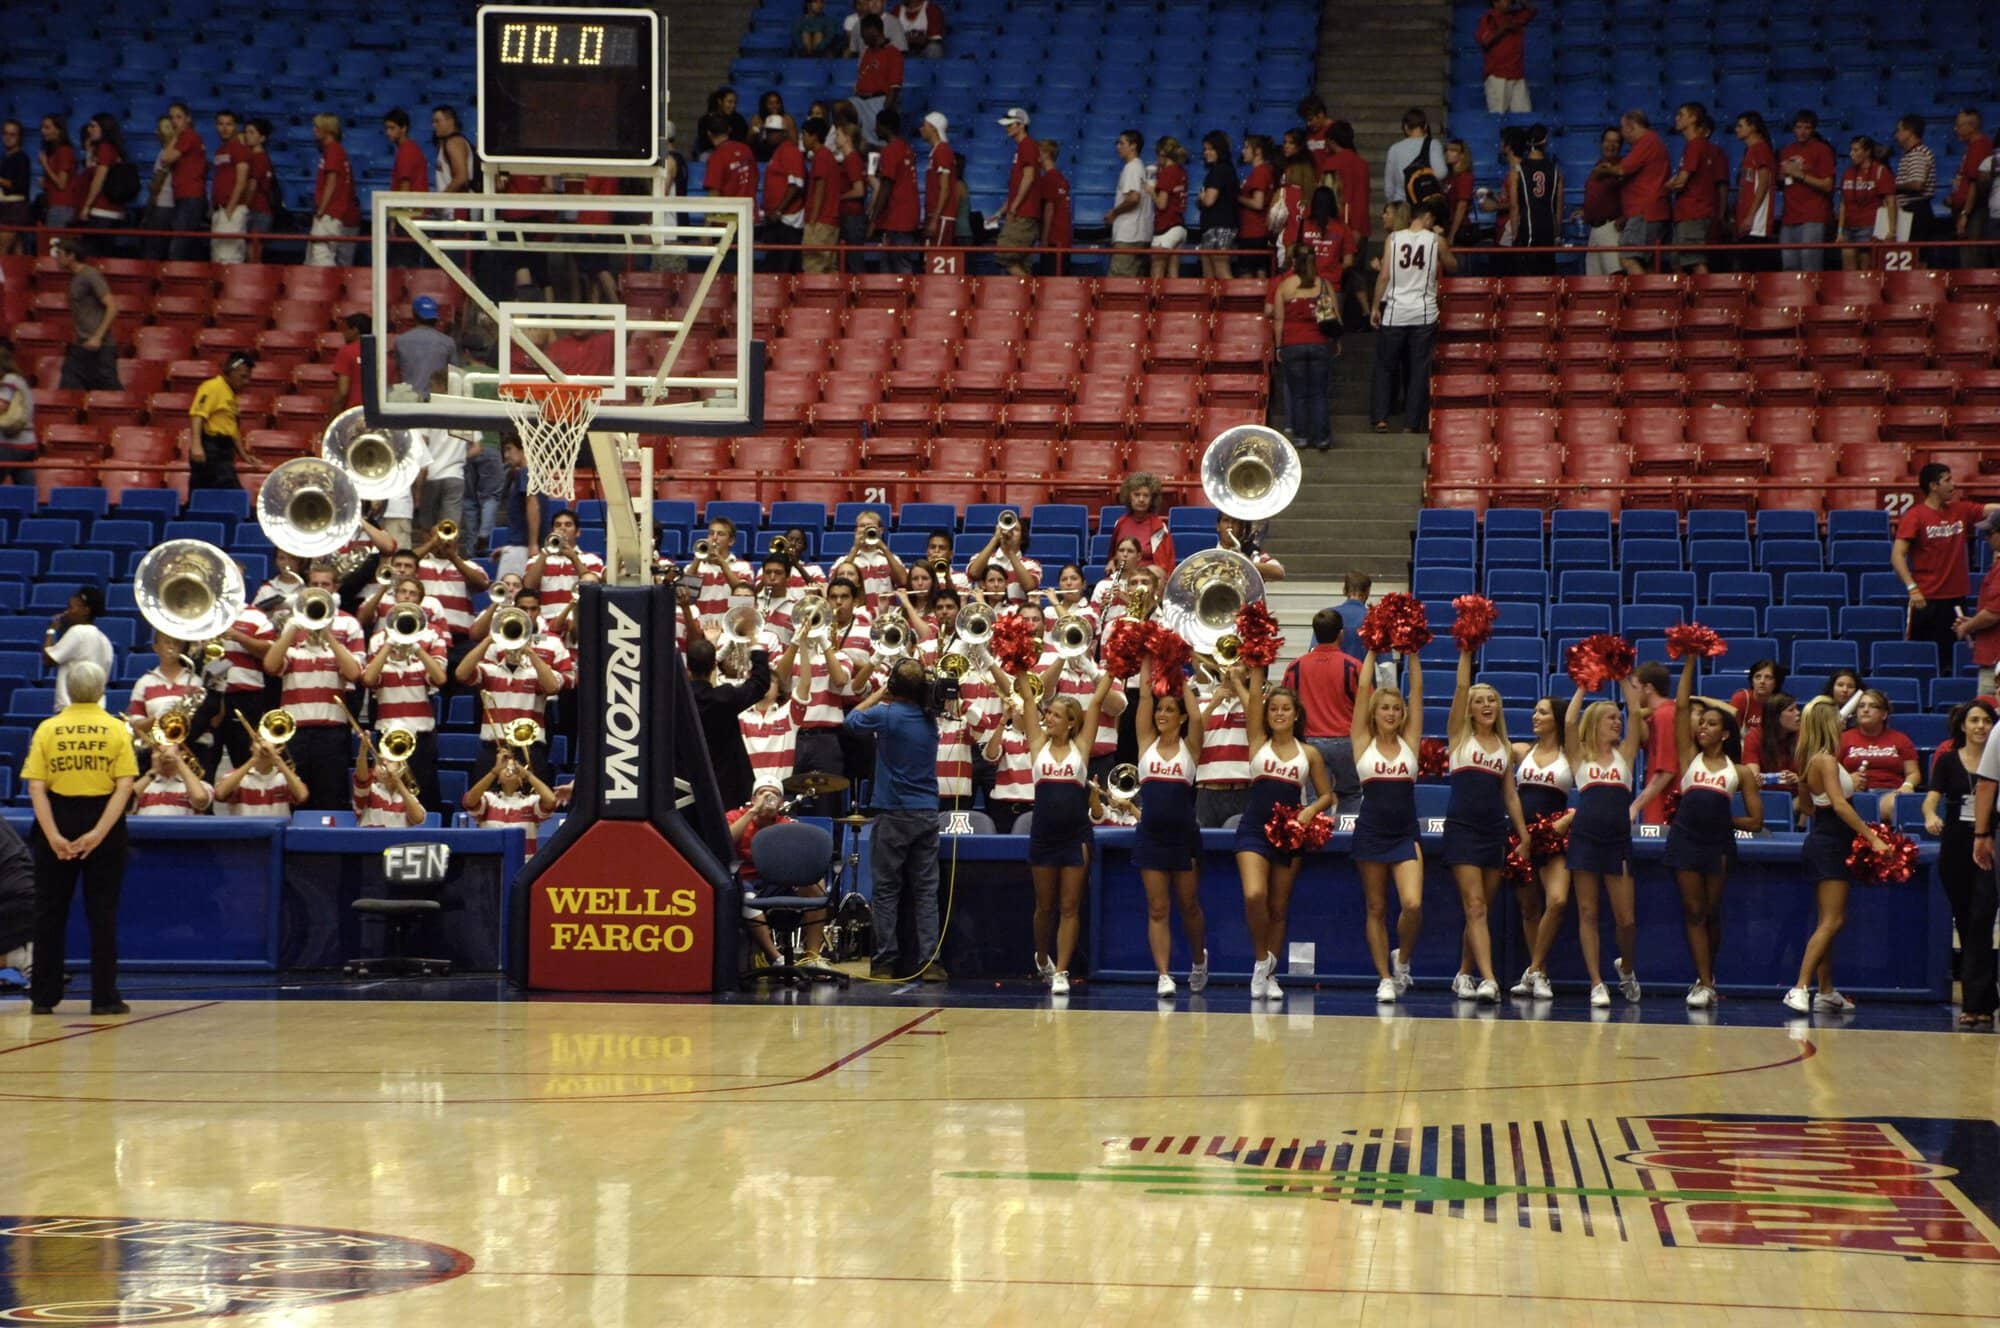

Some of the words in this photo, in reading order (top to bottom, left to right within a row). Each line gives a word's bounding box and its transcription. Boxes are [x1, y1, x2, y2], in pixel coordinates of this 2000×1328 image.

[501, 24, 604, 65] 00.0
[1532, 170, 1546, 198] 3
[933, 256, 956, 273] 21
[1399, 244, 1426, 270] 34
[1885, 251, 1912, 270] 22
[864, 487, 886, 504] 21
[1884, 493, 1914, 516] 22
[605, 601, 641, 799] ARIZONA
[55, 725, 109, 735] EVENT
[57, 741, 107, 752] STAFF
[50, 755, 113, 773] SECURITY
[384, 843, 450, 880] FSN
[546, 887, 697, 917] WELLS
[550, 923, 694, 953] FARGO
